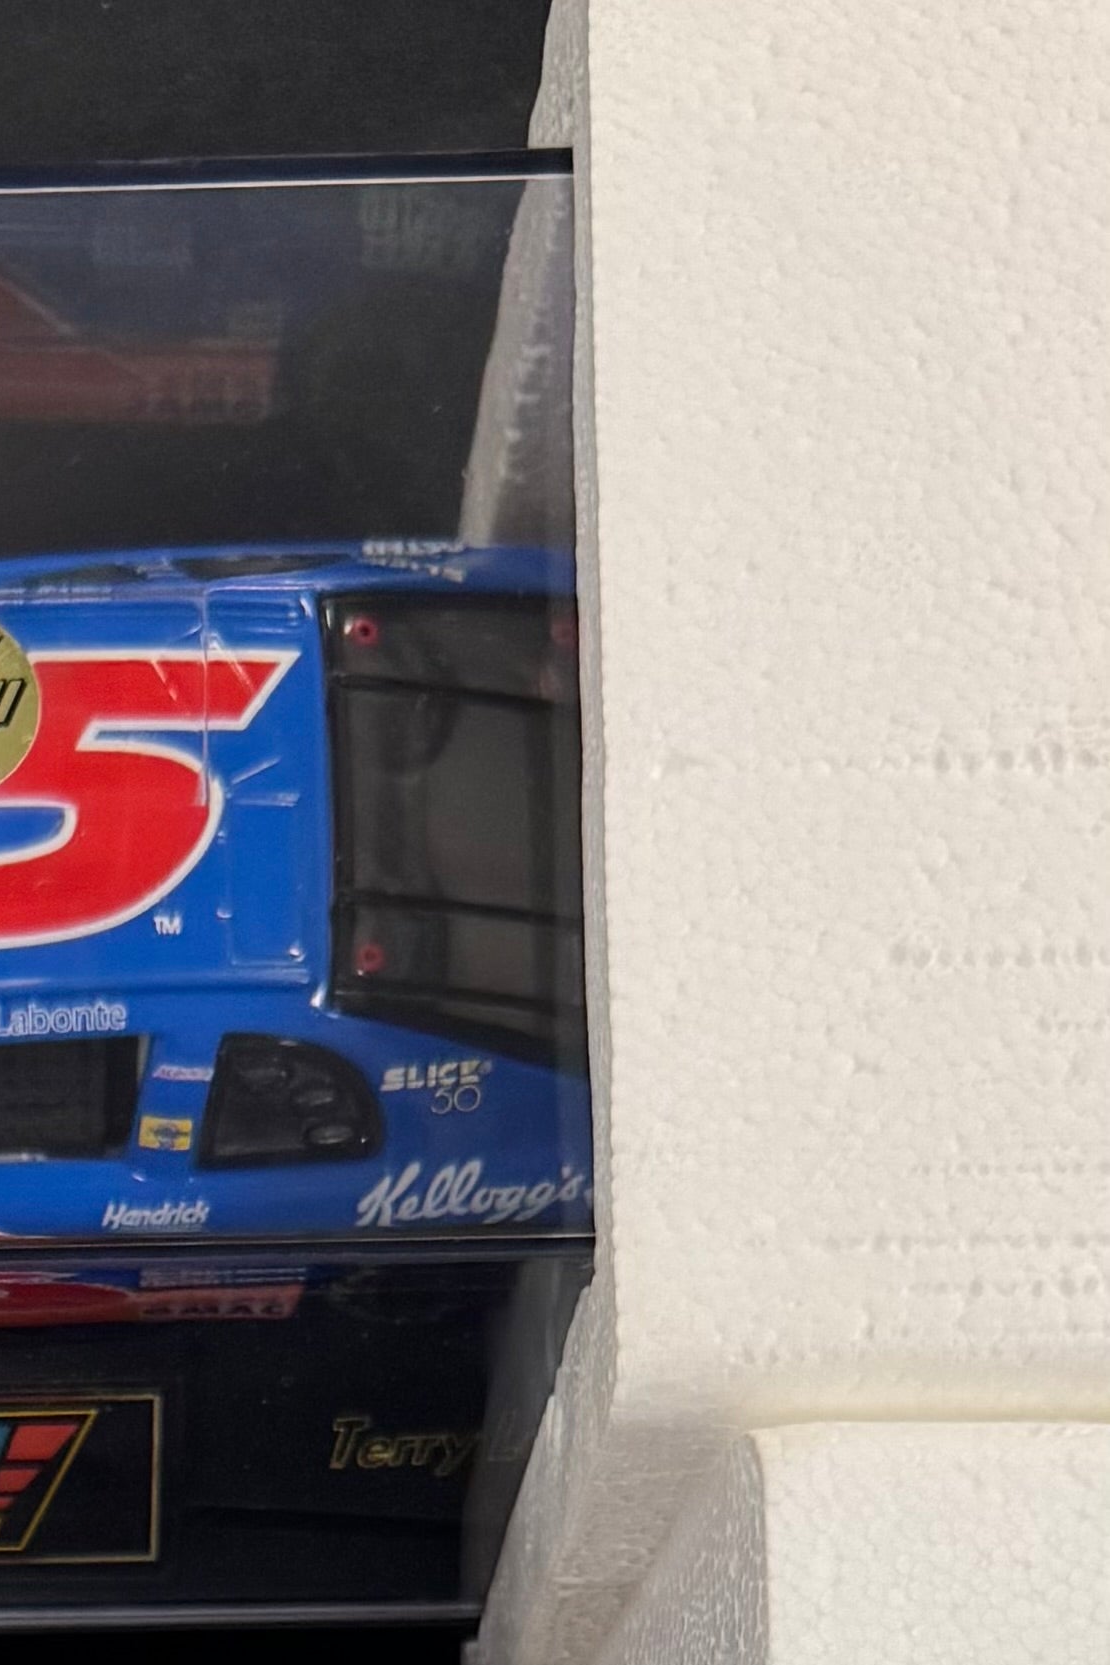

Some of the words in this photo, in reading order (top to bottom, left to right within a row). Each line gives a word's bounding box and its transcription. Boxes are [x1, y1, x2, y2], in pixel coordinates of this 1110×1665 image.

[154, 915, 182, 936] TM
[380, 1059, 484, 1092] SLICK
[430, 1084, 481, 1115] 50
[355, 1160, 588, 1230] Kellogg's
[102, 1200, 210, 1230] Hendrick
